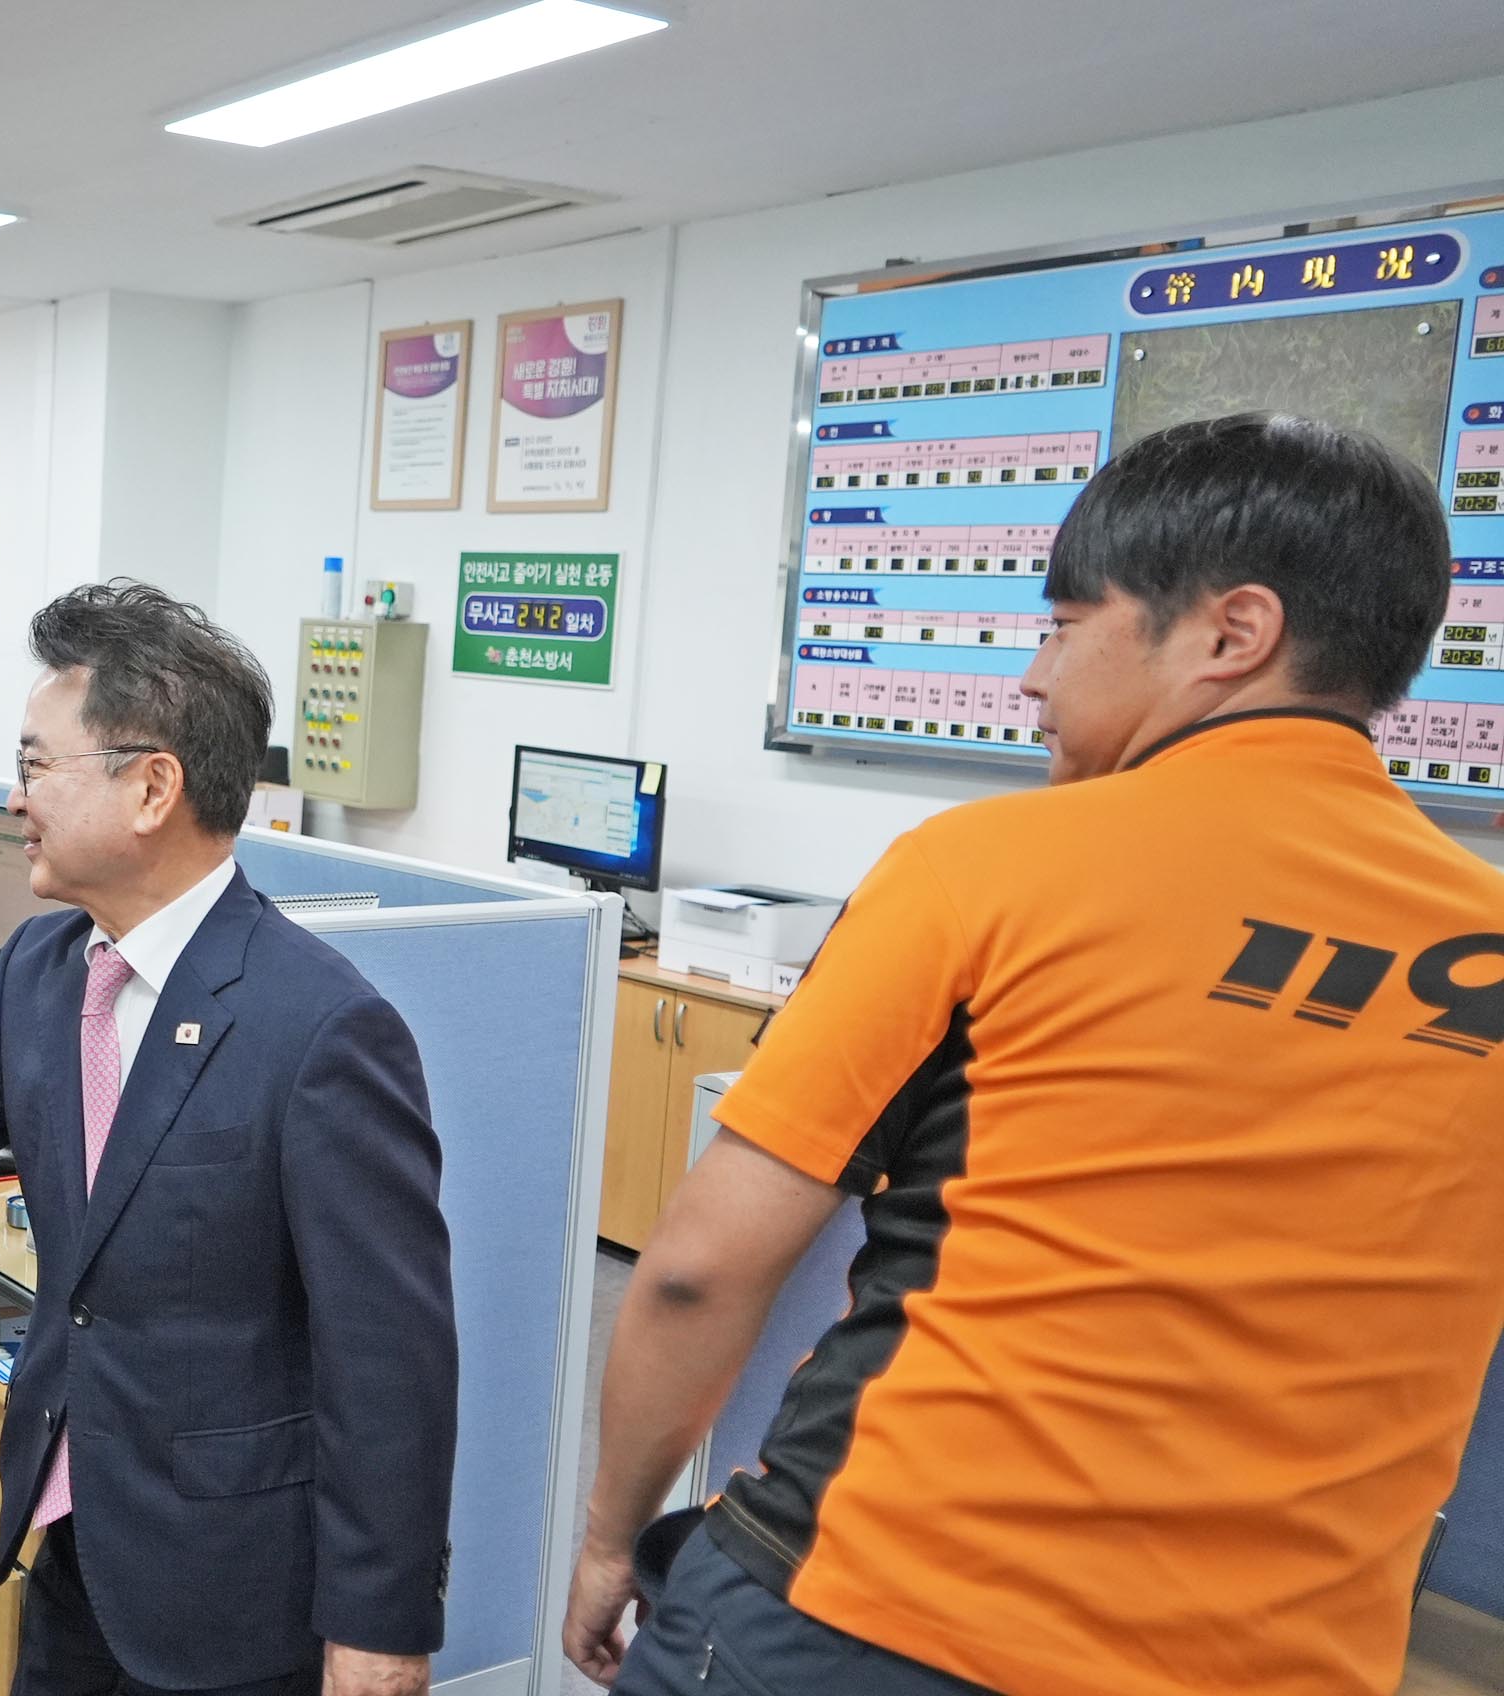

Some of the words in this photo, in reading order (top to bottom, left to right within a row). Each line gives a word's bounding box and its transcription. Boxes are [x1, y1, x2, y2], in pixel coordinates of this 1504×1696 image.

[512, 360, 546, 380] 새로운
[1458, 473, 1498, 487] 2024
[1455, 496, 1496, 510] 2025
[464, 561, 510, 583] 안전사고
[513, 562, 551, 585] 줄이기
[555, 563, 581, 586] 실천
[584, 563, 613, 587] 운동
[467, 601, 515, 625] 무사고
[517, 604, 562, 629] 242
[565, 612, 595, 634] 일차
[1444, 627, 1486, 640] 2024
[505, 646, 573, 672] 춘천소방서
[1441, 650, 1483, 664] 2025
[1431, 728, 1455, 737] 쓰레기
[1466, 741, 1499, 751] 군사시설
[1391, 761, 1409, 775] 94
[1433, 764, 1449, 778] 10
[1207, 917, 1504, 1058] 119
